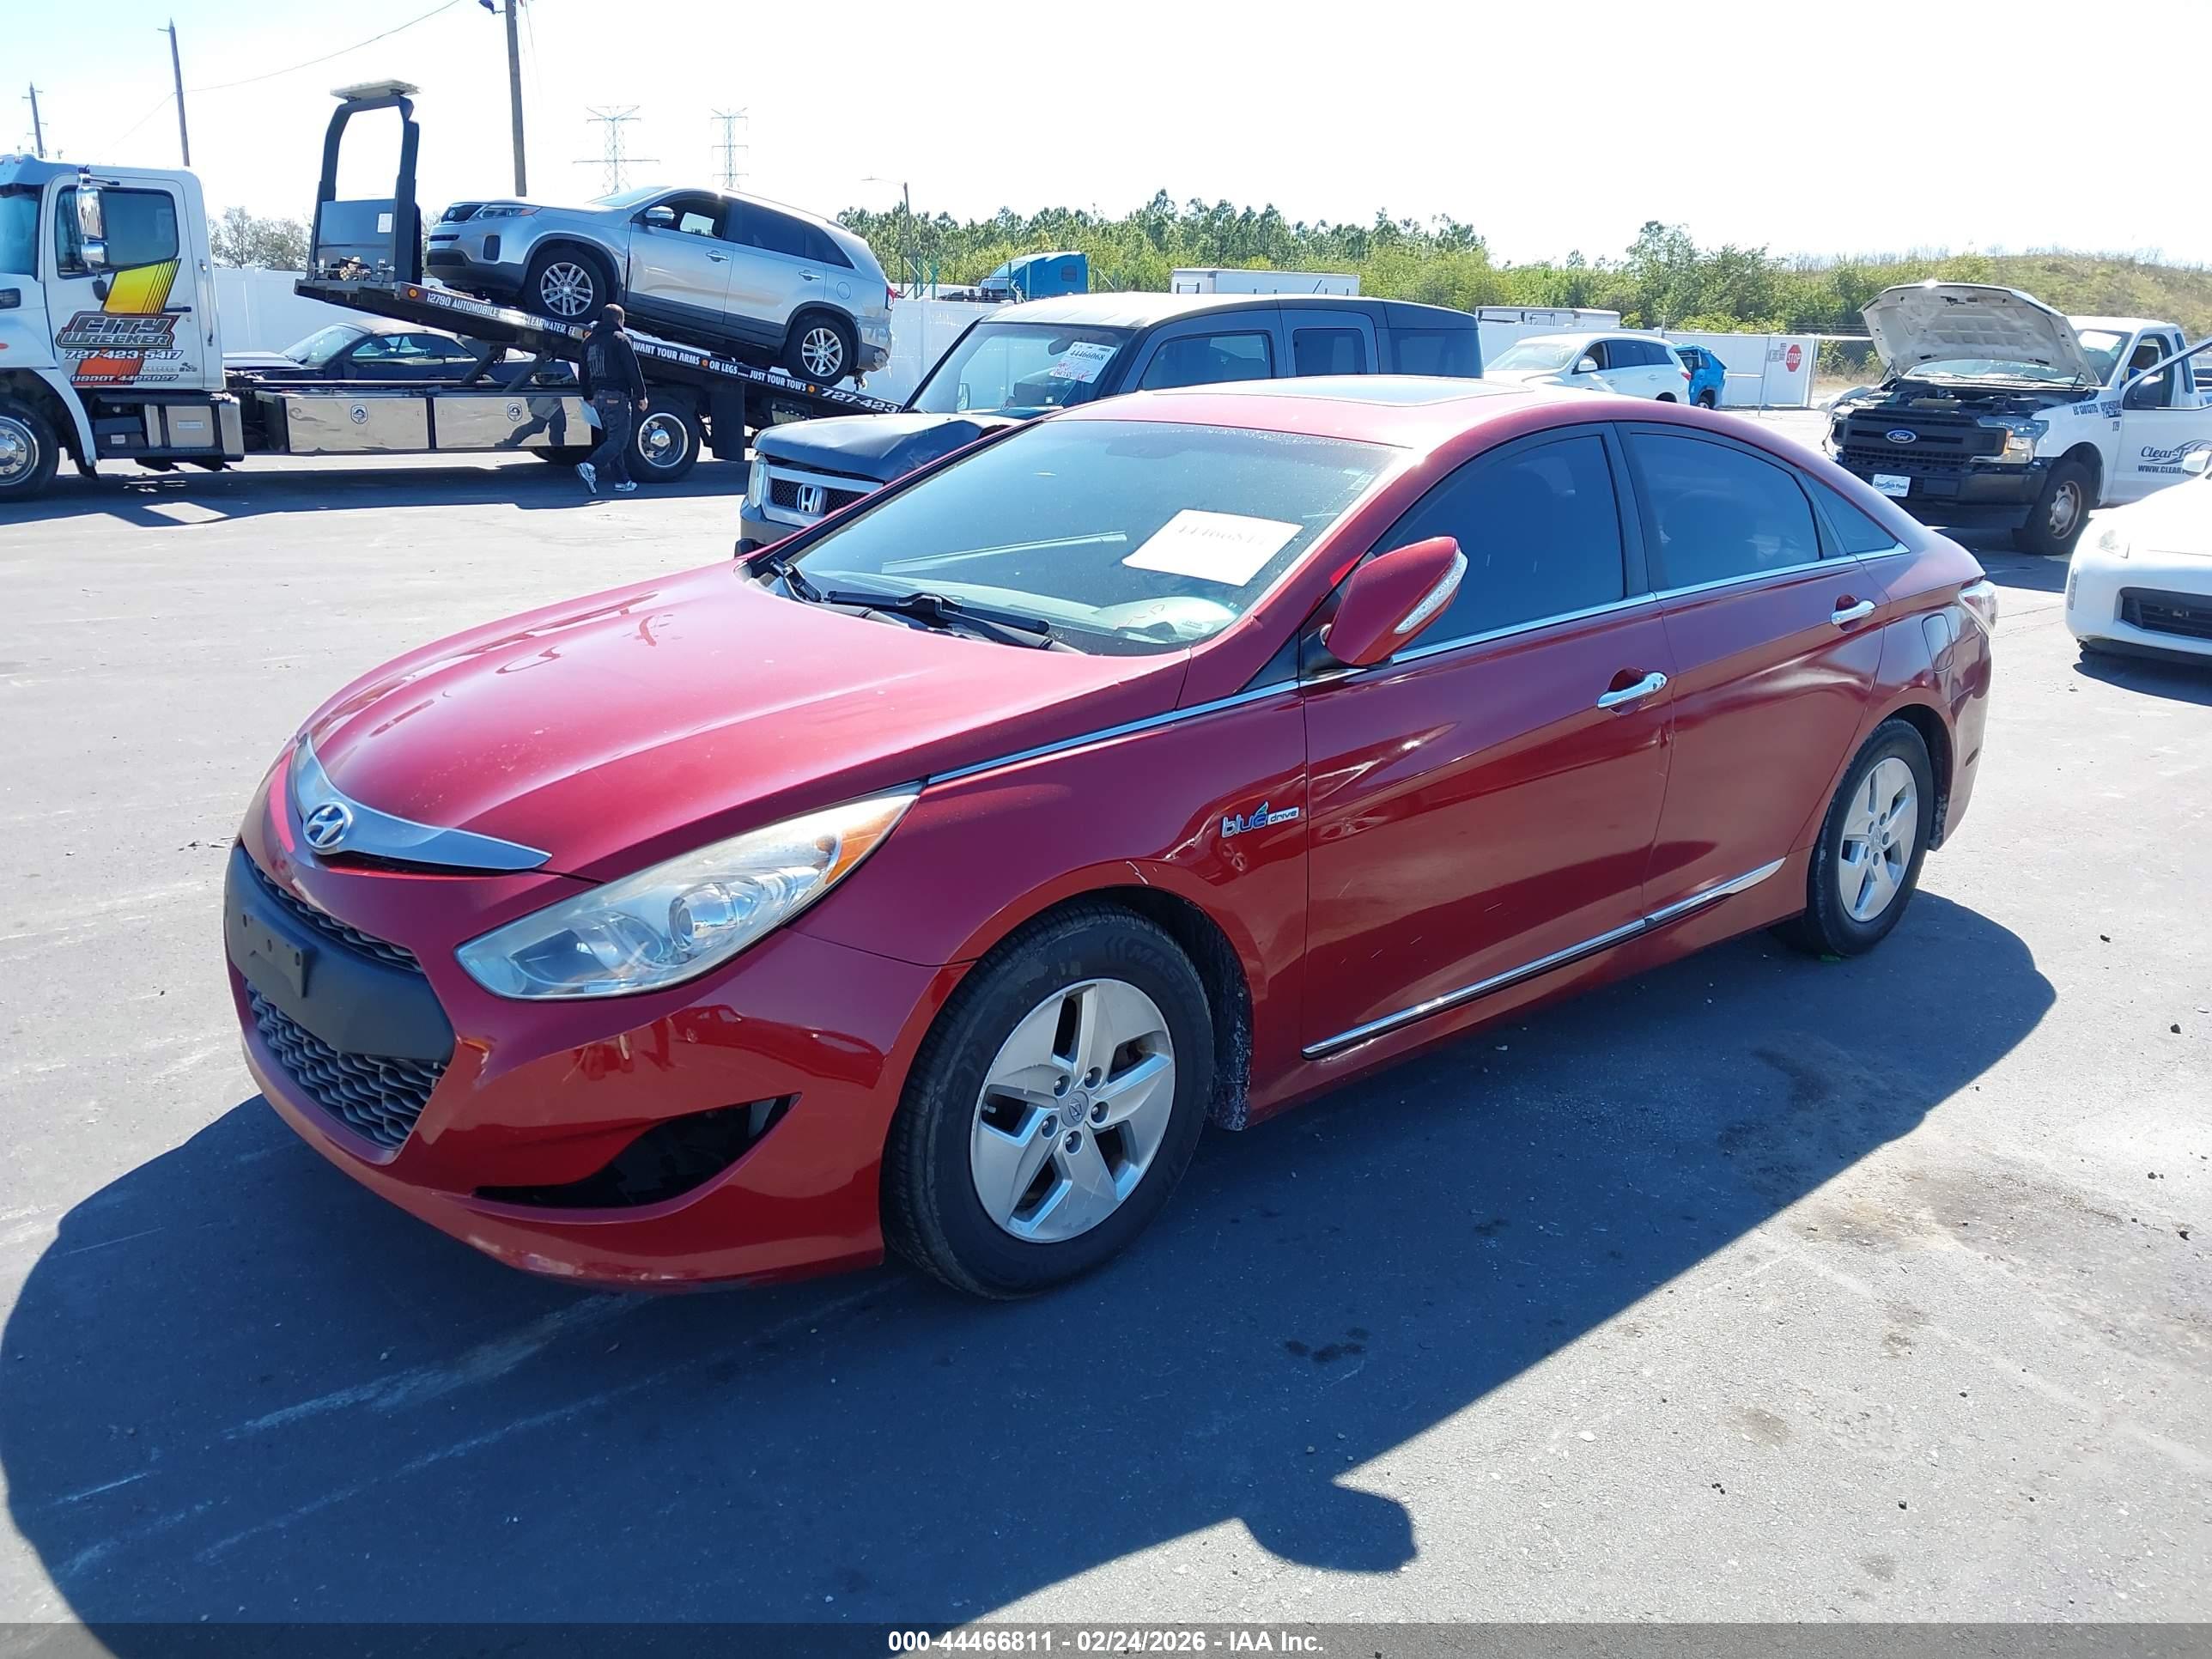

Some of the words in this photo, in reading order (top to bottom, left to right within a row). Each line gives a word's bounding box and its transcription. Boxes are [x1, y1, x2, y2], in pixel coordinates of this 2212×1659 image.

[70, 315, 173, 335] CITY
[452, 299, 498, 317] AUTOMOBILE
[568, 325, 576, 336] FL
[60, 331, 170, 345] WRECKER
[65, 349, 184, 361] 727-423-5417
[633, 341, 655, 355] WANT
[656, 347, 678, 361] YOUR
[678, 352, 701, 365] ARMS
[708, 360, 720, 371] OR
[749, 369, 767, 382] JUST
[767, 374, 786, 386] YOUR
[1786, 352, 1802, 364] STOP
[1221, 811, 1268, 838] blue
[1269, 809, 1297, 823] drive
